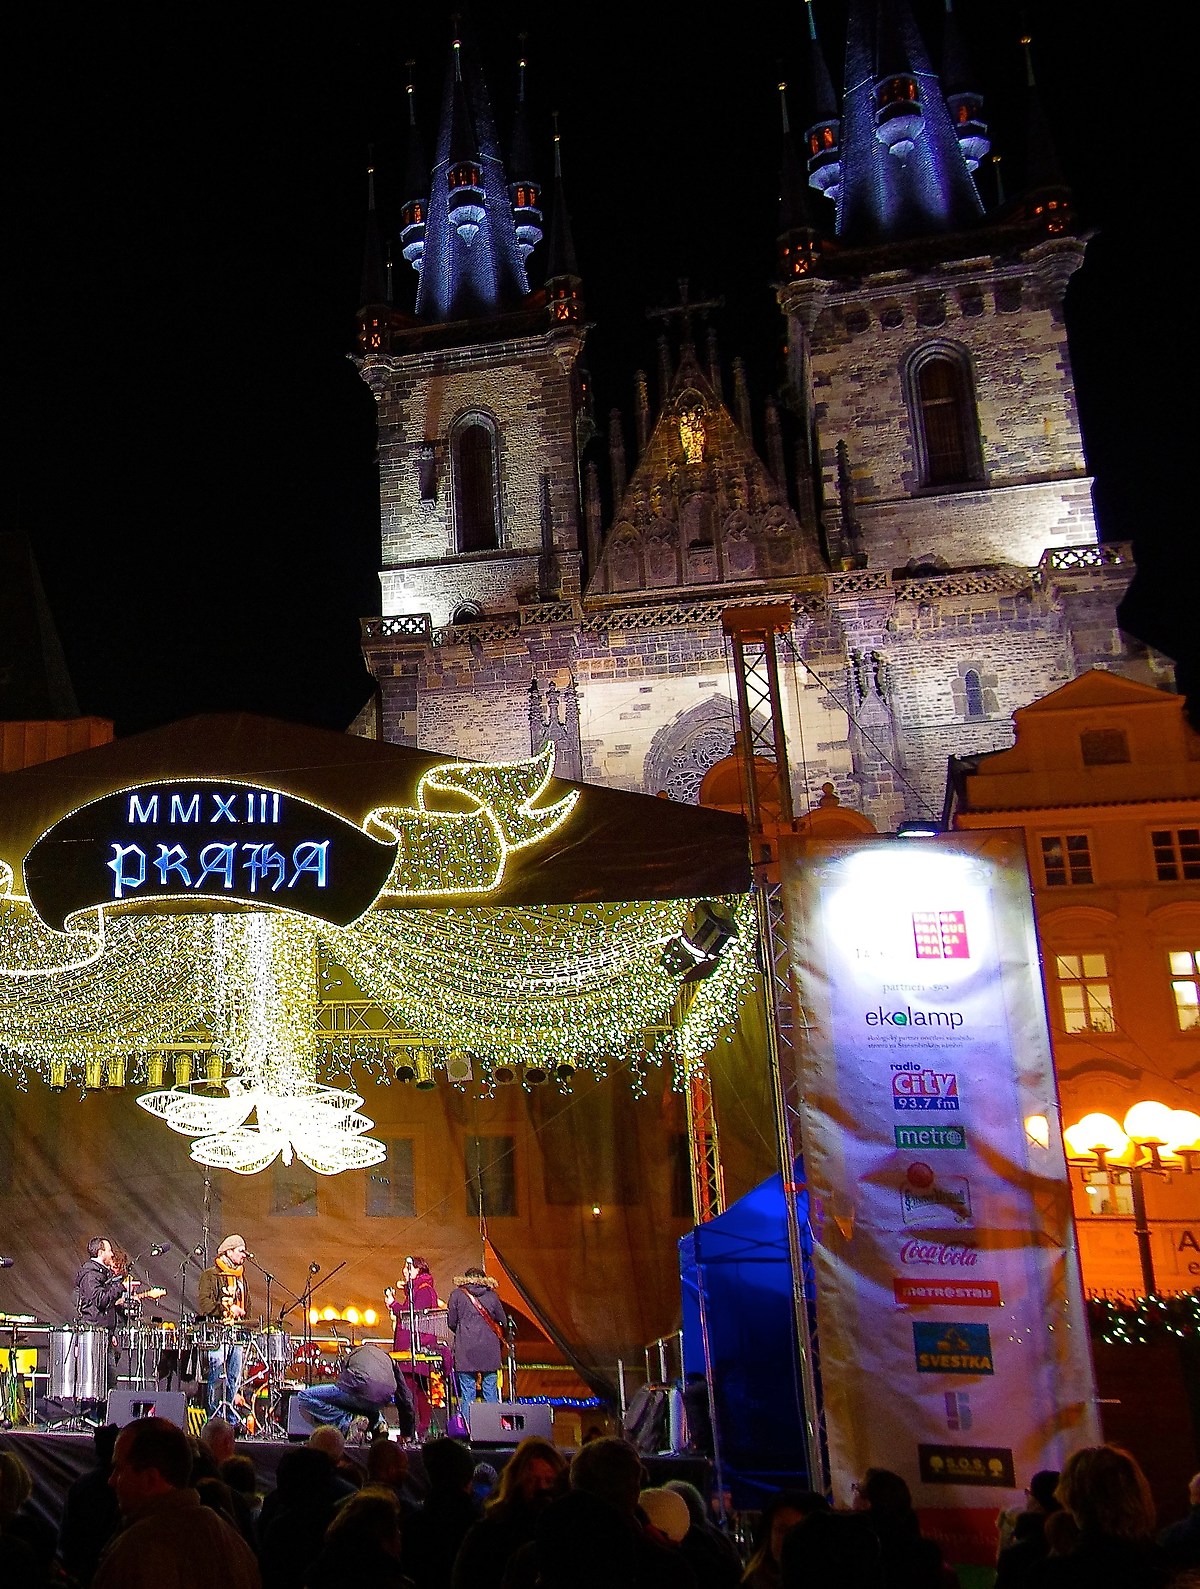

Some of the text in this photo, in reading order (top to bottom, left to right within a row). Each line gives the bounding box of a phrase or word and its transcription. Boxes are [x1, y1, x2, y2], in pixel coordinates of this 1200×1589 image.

[128, 794, 281, 823] MMXIII
[106, 839, 330, 898] PRAHA
[942, 924, 965, 933] GUE
[917, 935, 960, 944] PRA GA
[918, 945, 941, 955] PRA
[865, 1006, 963, 1030] ekolamp
[890, 1062, 921, 1071] radio
[898, 1098, 956, 1108] 93.7 fm
